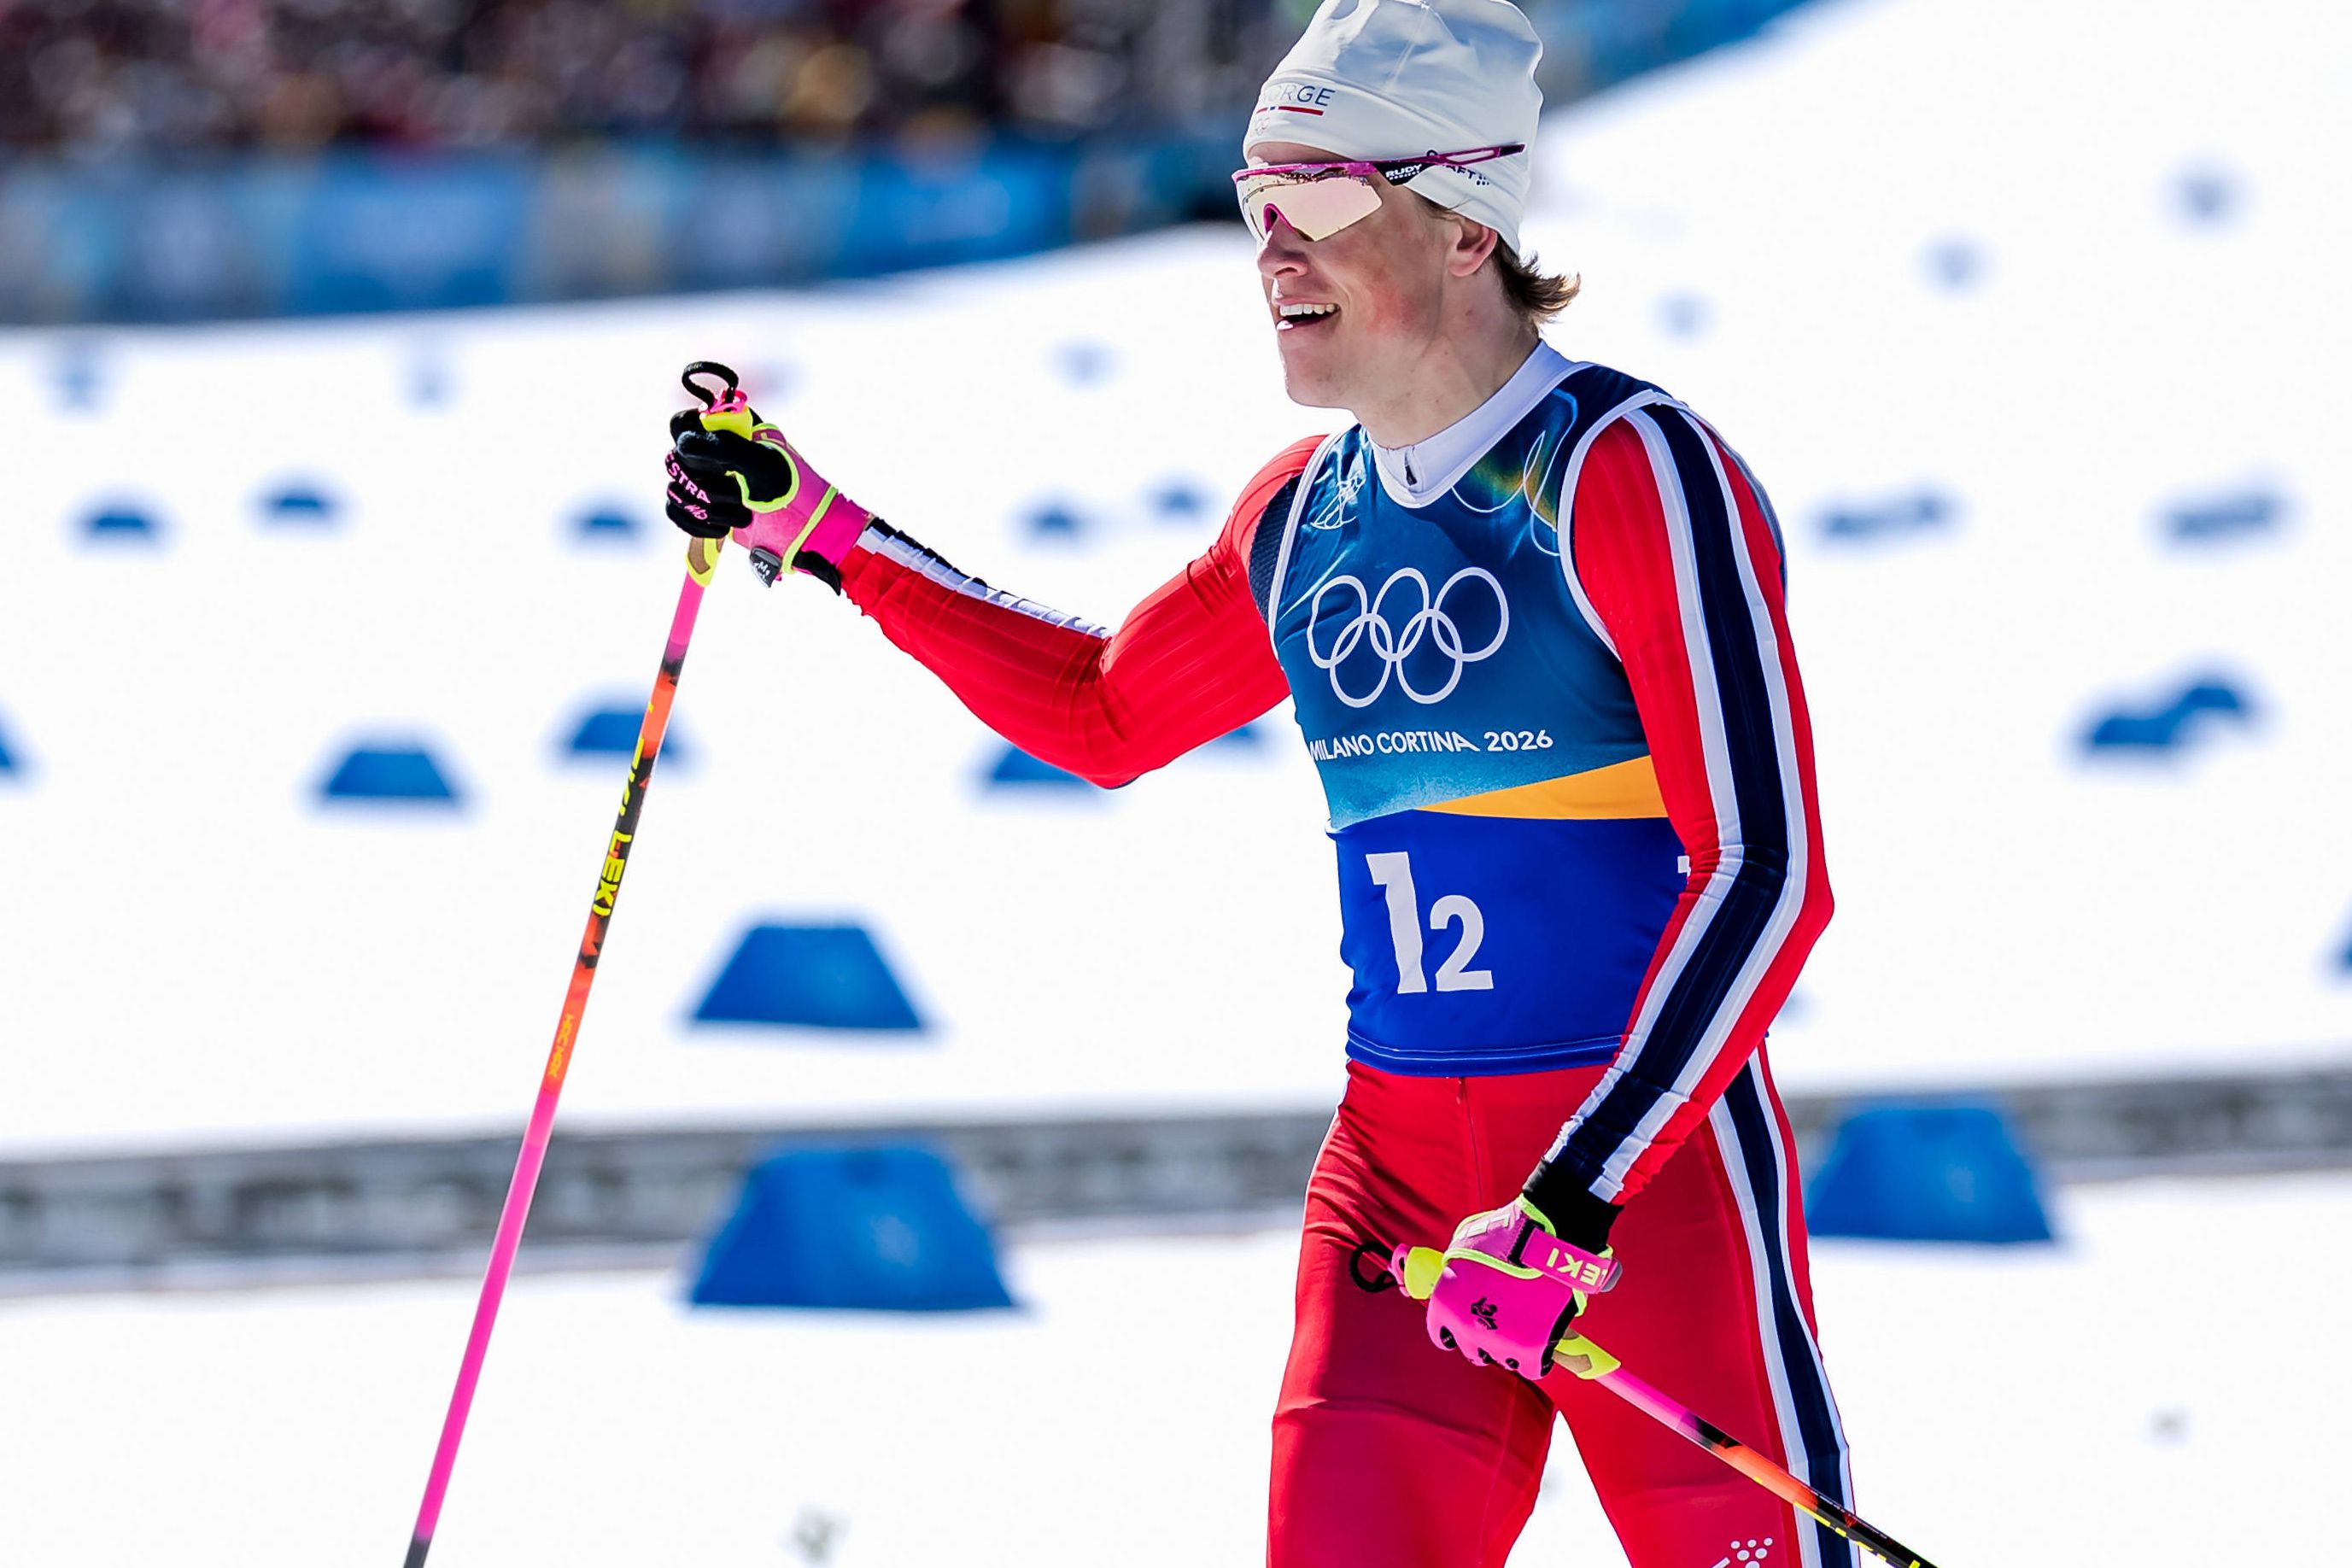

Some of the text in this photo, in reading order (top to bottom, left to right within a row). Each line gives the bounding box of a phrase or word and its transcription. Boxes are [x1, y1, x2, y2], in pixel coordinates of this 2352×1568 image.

[1385, 163, 1422, 178] RUDY
[1309, 729, 1553, 761] MILANO CORTINA 2026
[592, 829, 633, 916] LEKI
